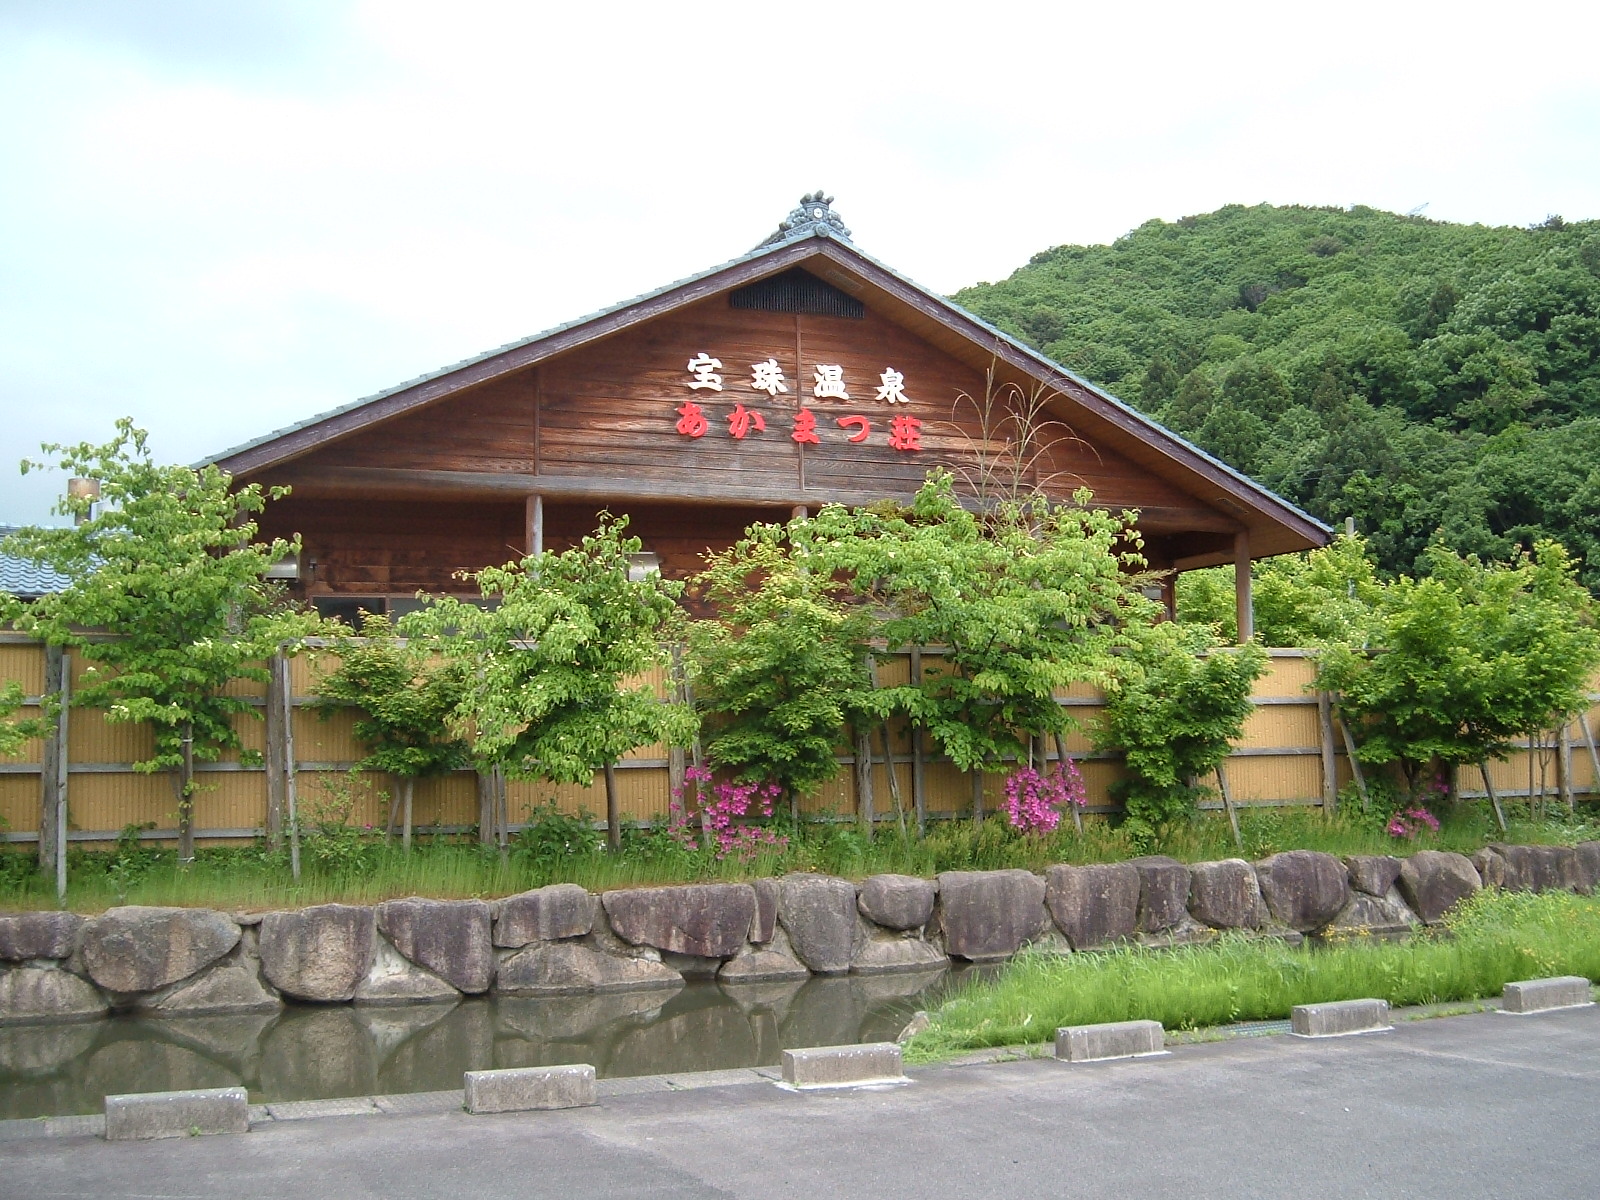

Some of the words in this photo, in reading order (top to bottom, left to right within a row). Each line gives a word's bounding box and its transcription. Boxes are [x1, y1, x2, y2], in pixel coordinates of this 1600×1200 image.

[687, 353, 910, 404] 宝珠温泉
[675, 401, 922, 450] あかまつ荘
